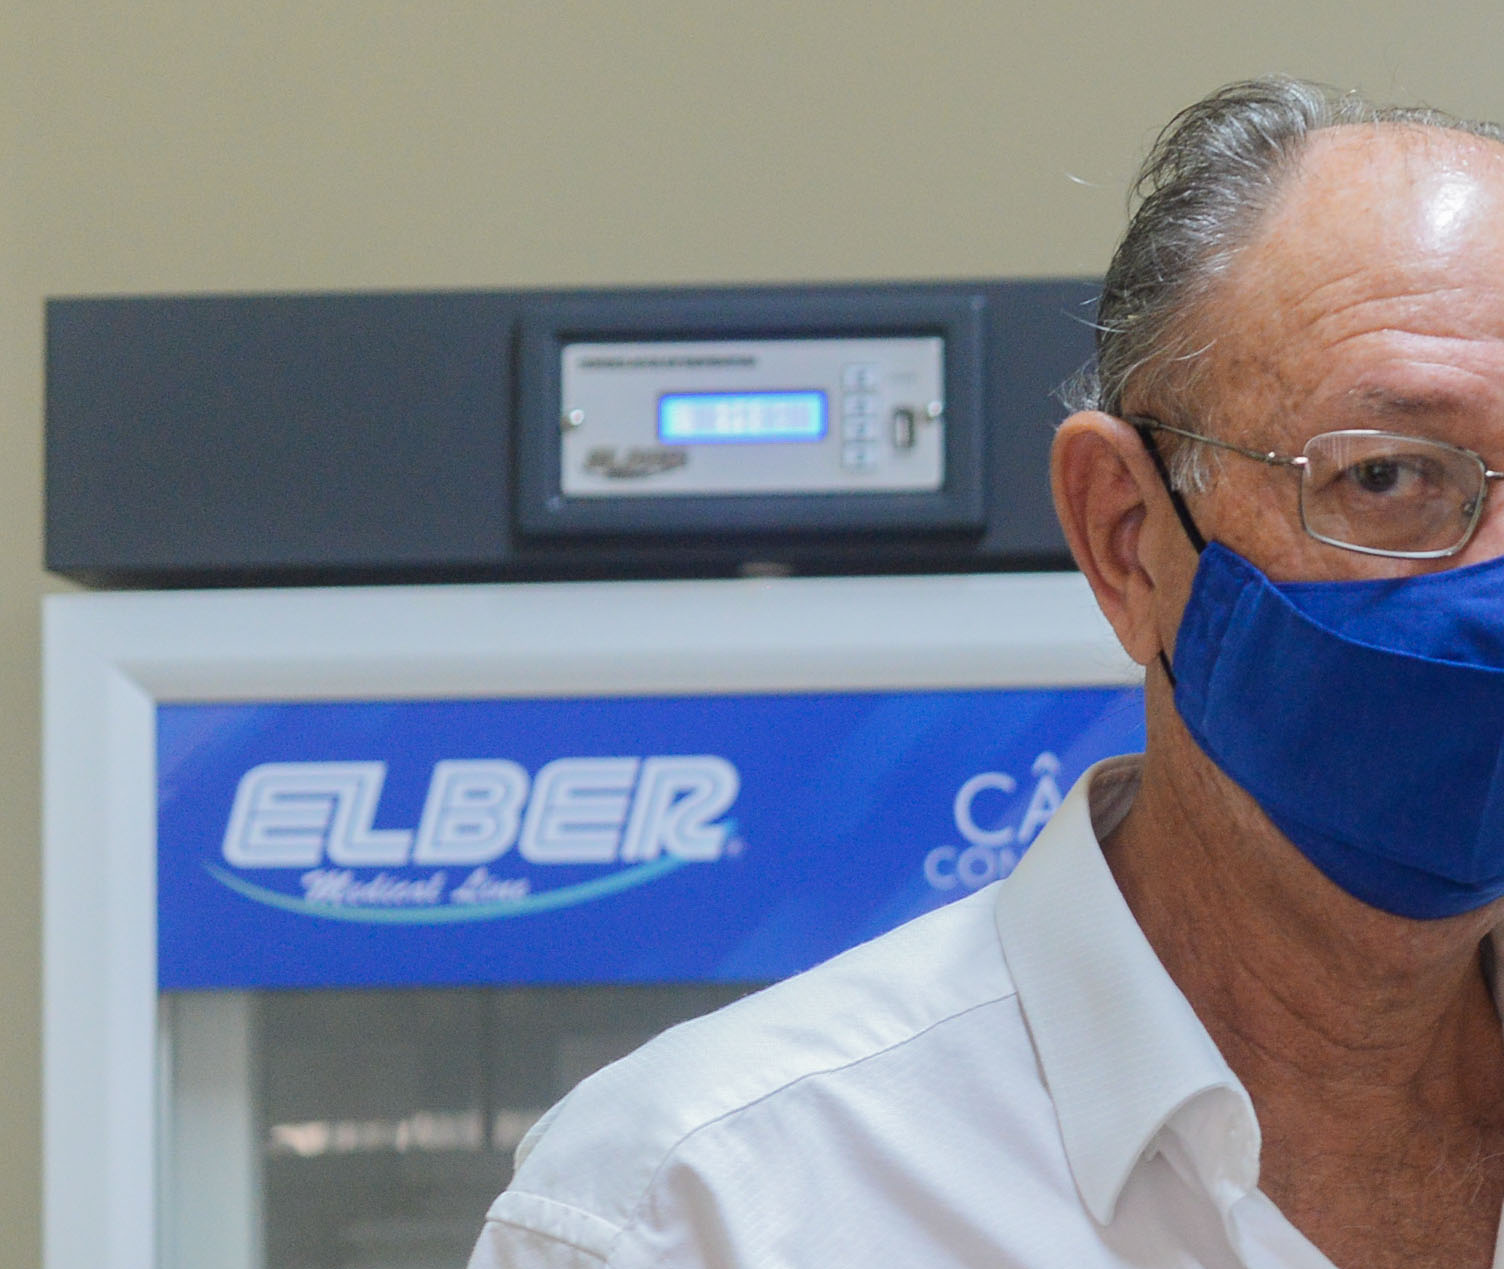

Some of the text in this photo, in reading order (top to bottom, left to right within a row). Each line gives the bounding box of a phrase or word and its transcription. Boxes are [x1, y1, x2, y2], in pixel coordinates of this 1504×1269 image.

[221, 755, 740, 869] ELBER
[302, 866, 531, 906] Medical Line
